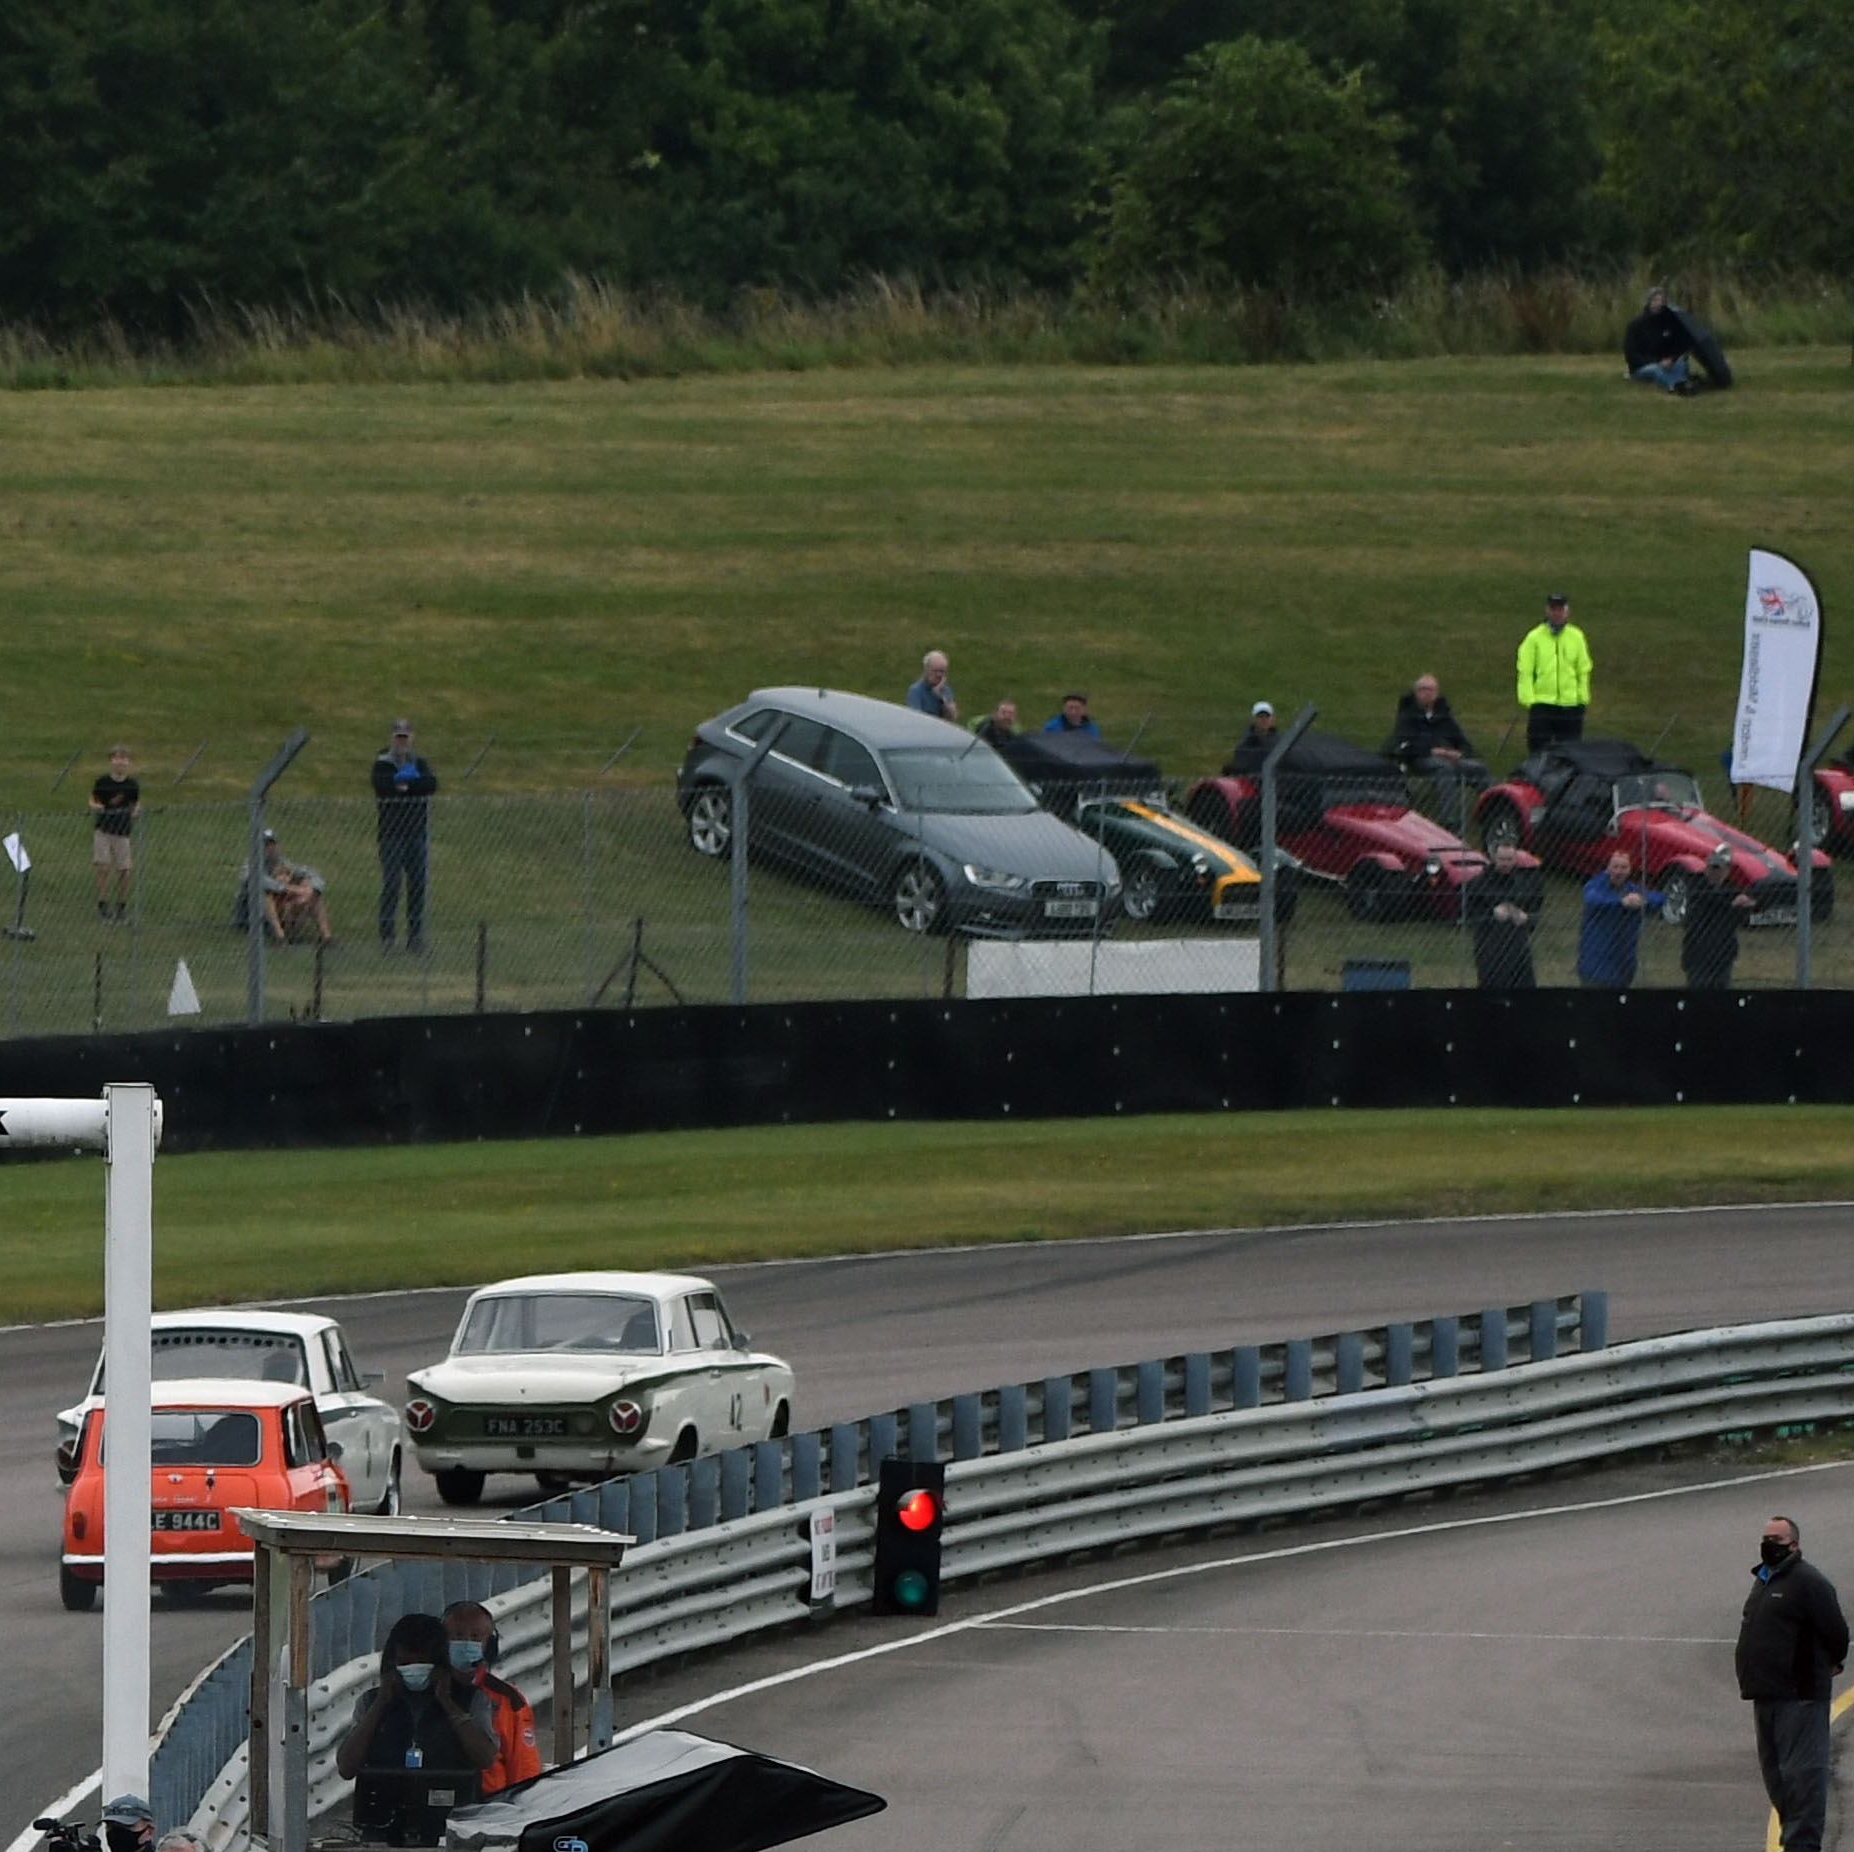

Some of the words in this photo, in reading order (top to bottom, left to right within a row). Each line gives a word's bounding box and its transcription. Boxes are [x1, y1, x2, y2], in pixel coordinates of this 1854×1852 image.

[488, 1418, 517, 1433] FNA
[524, 1418, 564, 1433] 253C
[172, 1513, 218, 1530] 944C
